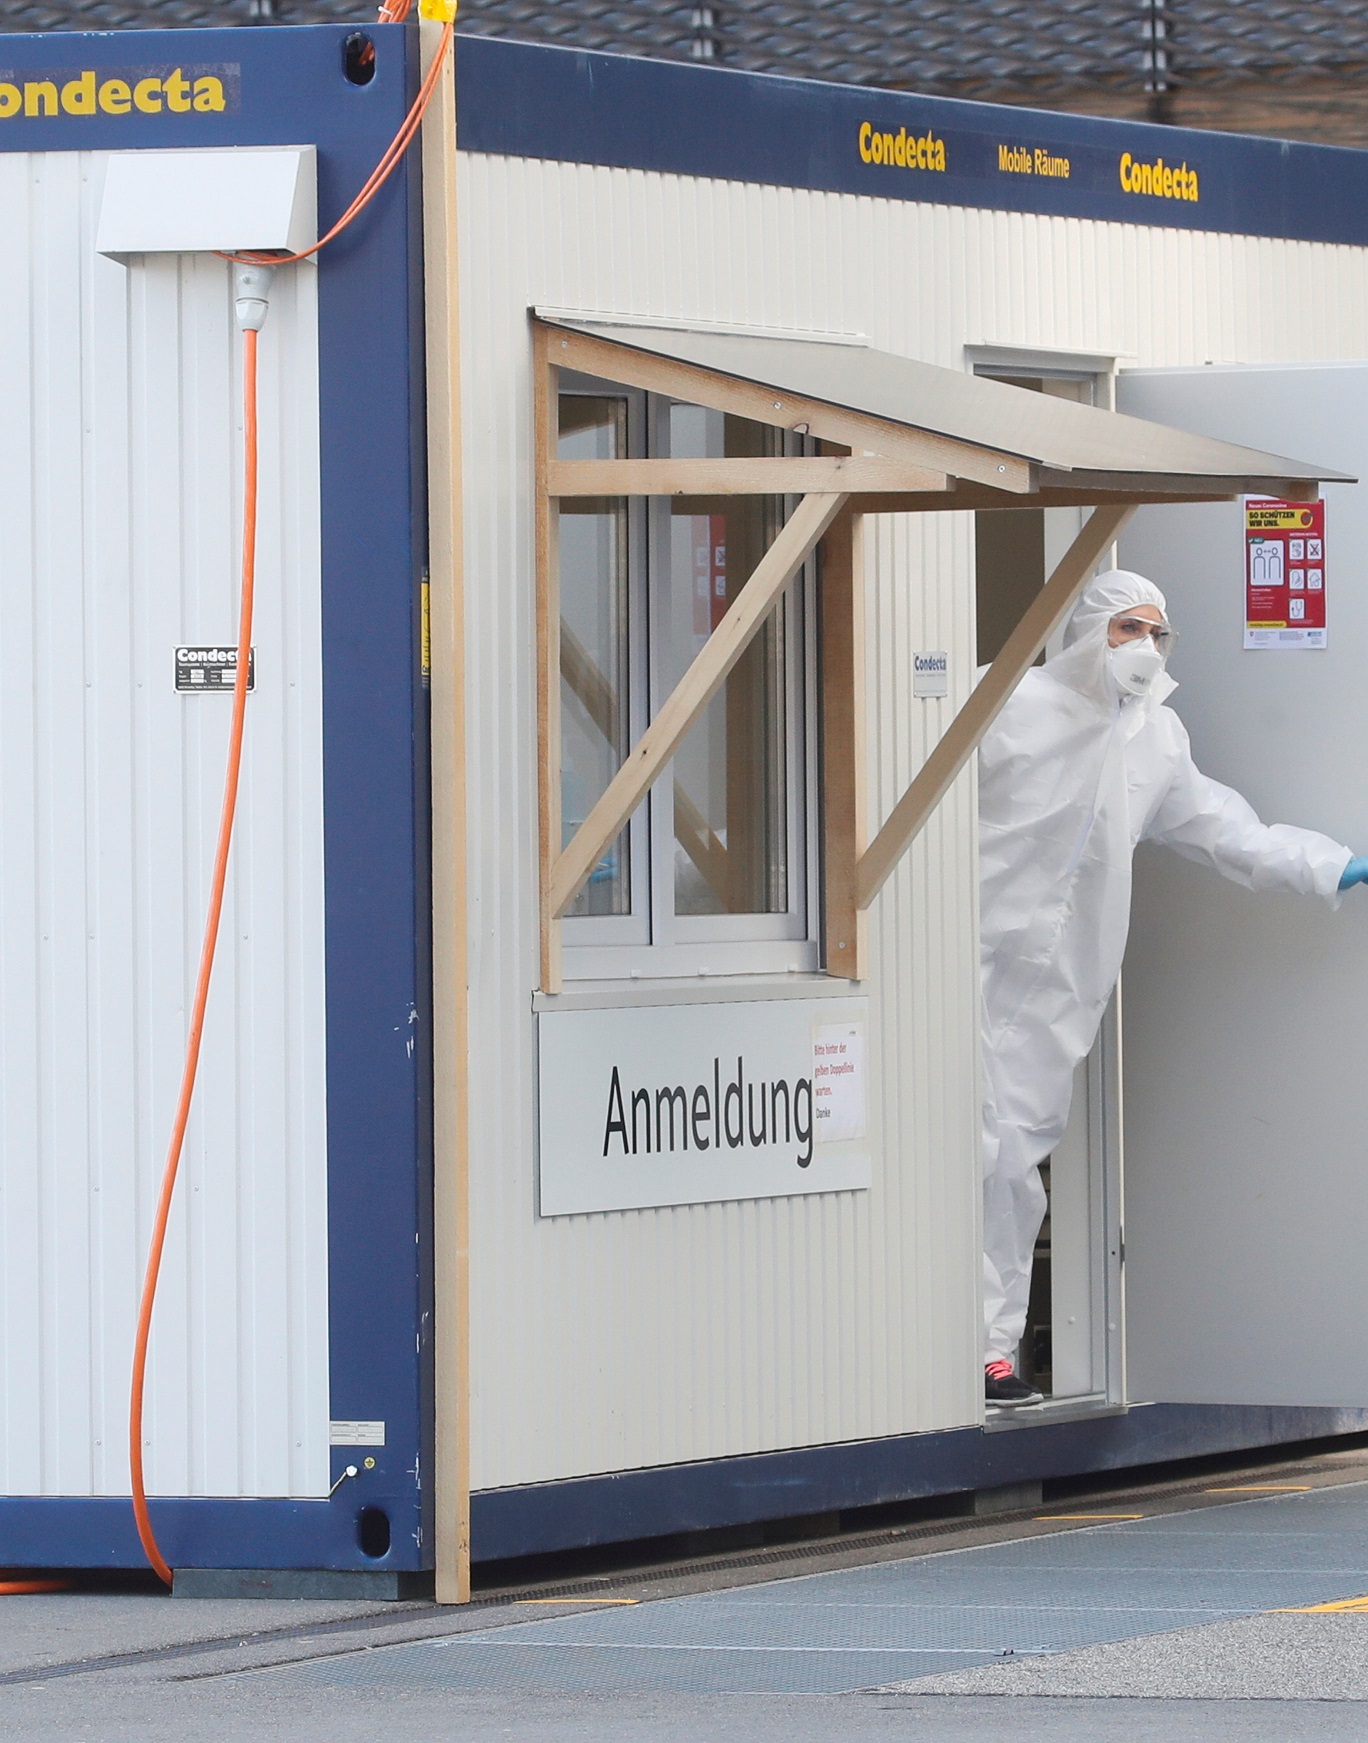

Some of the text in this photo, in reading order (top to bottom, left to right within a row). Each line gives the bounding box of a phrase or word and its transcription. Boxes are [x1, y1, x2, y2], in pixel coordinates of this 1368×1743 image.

[0, 68, 226, 118] ondecta
[859, 121, 946, 172] Condecta
[998, 144, 1070, 178] Mobile Räume
[1119, 152, 1199, 202] Condecta
[1249, 510, 1295, 519] SO SCHÜTZEN
[177, 648, 252, 662] Condec
[914, 655, 947, 671] Condecta
[814, 1042, 847, 1055] Bitte hinter der
[815, 1062, 854, 1078] gelben Doppellinie
[602, 1055, 813, 1168] Anmeldung
[816, 1107, 830, 1119] Danke
